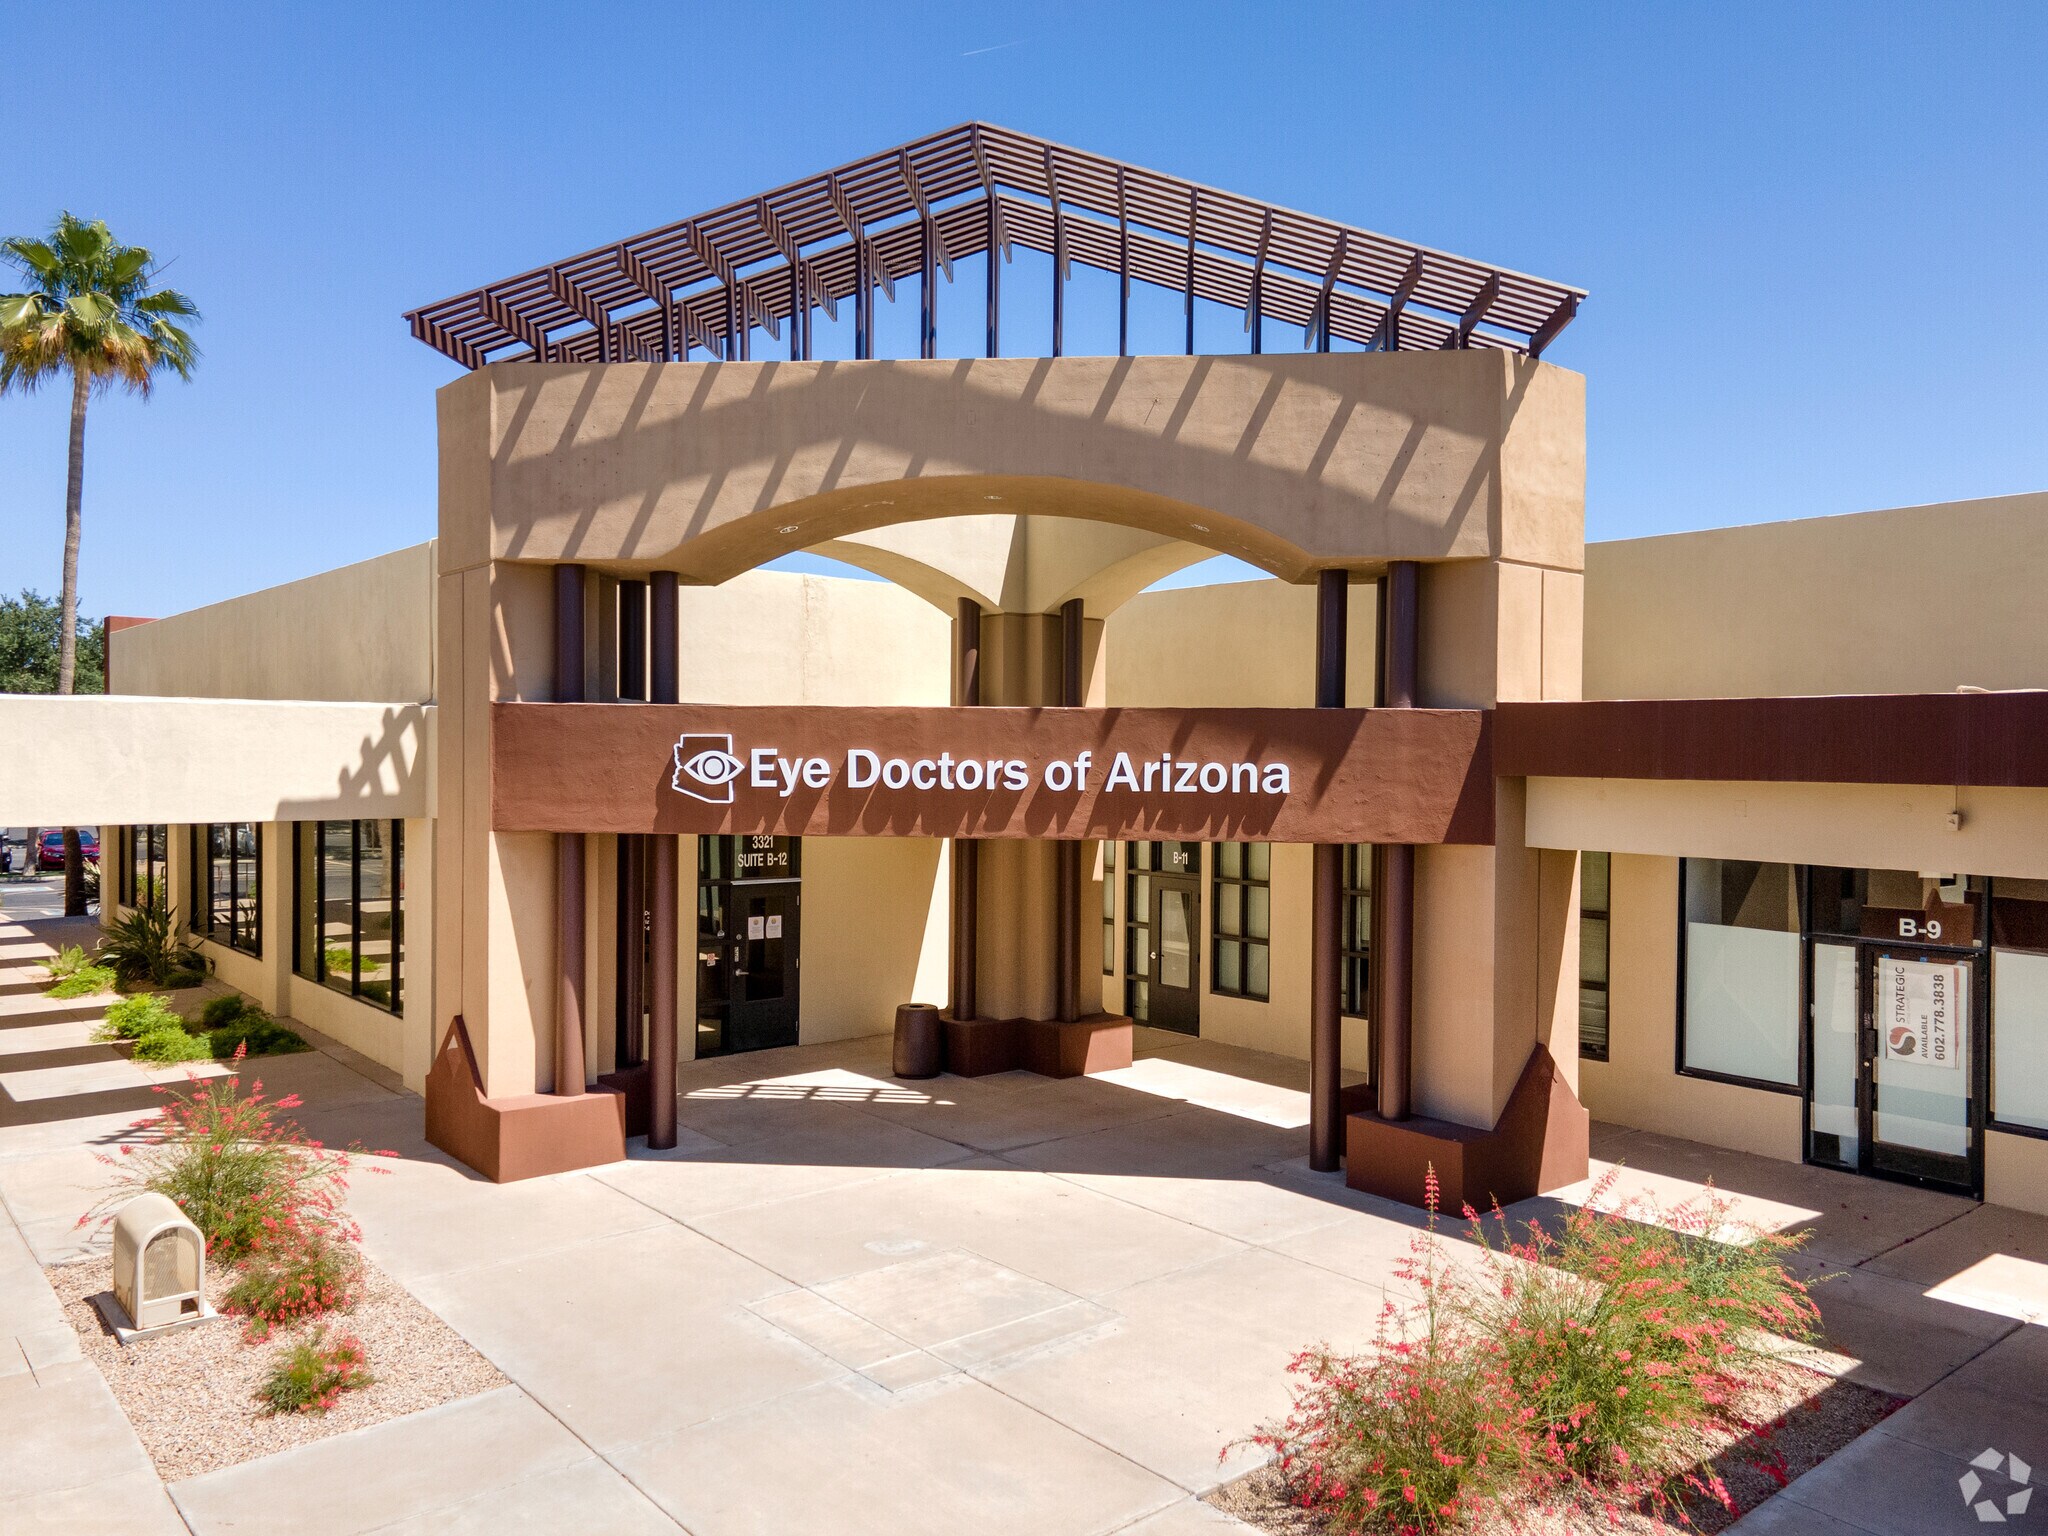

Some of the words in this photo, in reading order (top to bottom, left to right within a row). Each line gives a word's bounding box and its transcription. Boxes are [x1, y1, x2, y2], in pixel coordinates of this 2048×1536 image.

[751, 748, 831, 798] Eye
[847, 749, 1030, 791] Doctors
[1044, 750, 1092, 791] of
[1105, 752, 1290, 794] Arizona
[752, 835, 774, 849] 3321
[1173, 851, 1188, 865] B-11
[737, 853, 764, 868] SUITE
[767, 851, 788, 866] B-12
[1899, 917, 1942, 940] B-9
[1895, 967, 1906, 1024] STRATEGIC
[1932, 974, 1946, 1061] 602.778.3838
[1920, 1014, 1929, 1059] AVAILABLE
